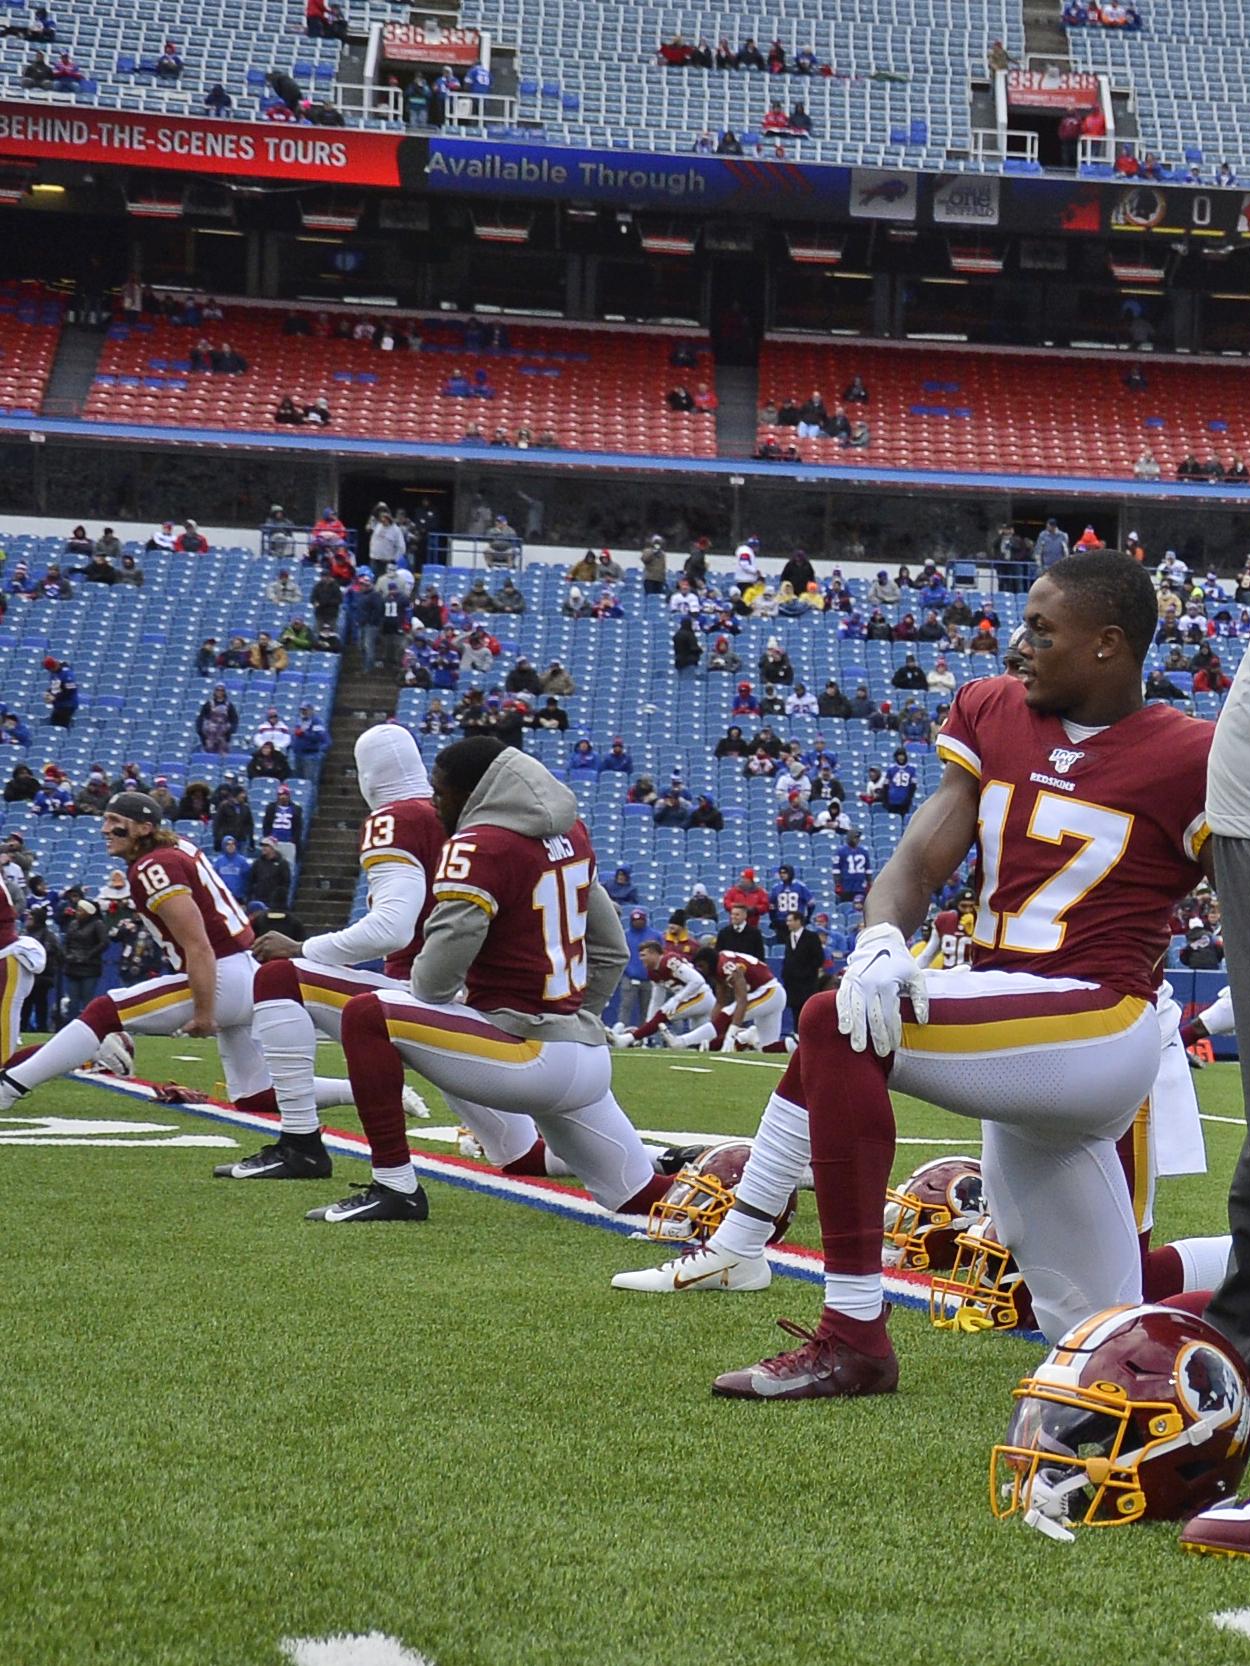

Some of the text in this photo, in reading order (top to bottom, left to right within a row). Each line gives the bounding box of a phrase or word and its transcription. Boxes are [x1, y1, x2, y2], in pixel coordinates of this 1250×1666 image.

[0, 115, 347, 167] BEHIND-THE-SCENES TOURS
[426, 151, 705, 195] Available Through
[1193, 197, 1211, 225] 0
[892, 771, 910, 788] 49
[1030, 772, 1076, 792] REDSKINS
[361, 815, 395, 851] 13
[543, 834, 575, 862] SIMS
[435, 841, 477, 880] 15
[846, 854, 866, 874] 12
[972, 779, 1135, 954] 17
[138, 864, 171, 896] 18
[777, 891, 798, 912] 88
[532, 858, 592, 1001] 15
